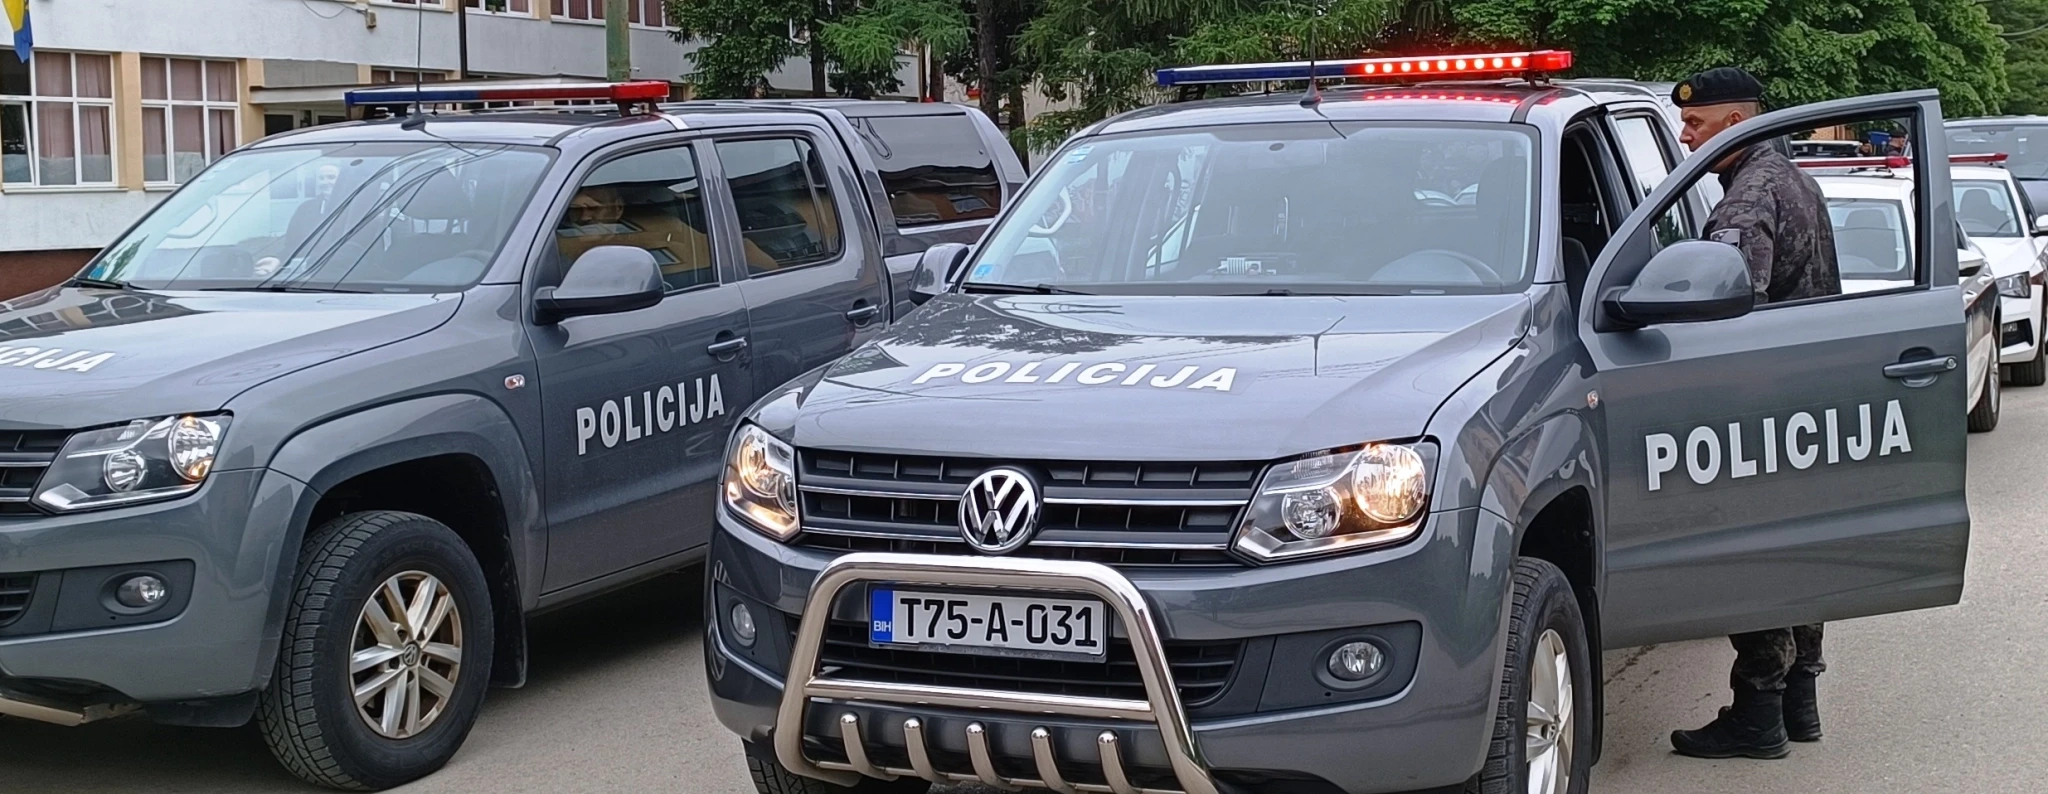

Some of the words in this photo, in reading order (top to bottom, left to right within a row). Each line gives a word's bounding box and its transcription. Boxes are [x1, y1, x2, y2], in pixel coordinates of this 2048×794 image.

[0, 346, 116, 372] CIJA
[911, 362, 1237, 391] POLICIJA
[576, 373, 725, 455] POLICIJA
[1645, 399, 1912, 491] POLICIJA
[873, 620, 892, 632] BIH
[900, 598, 1097, 647] T75-A-031
